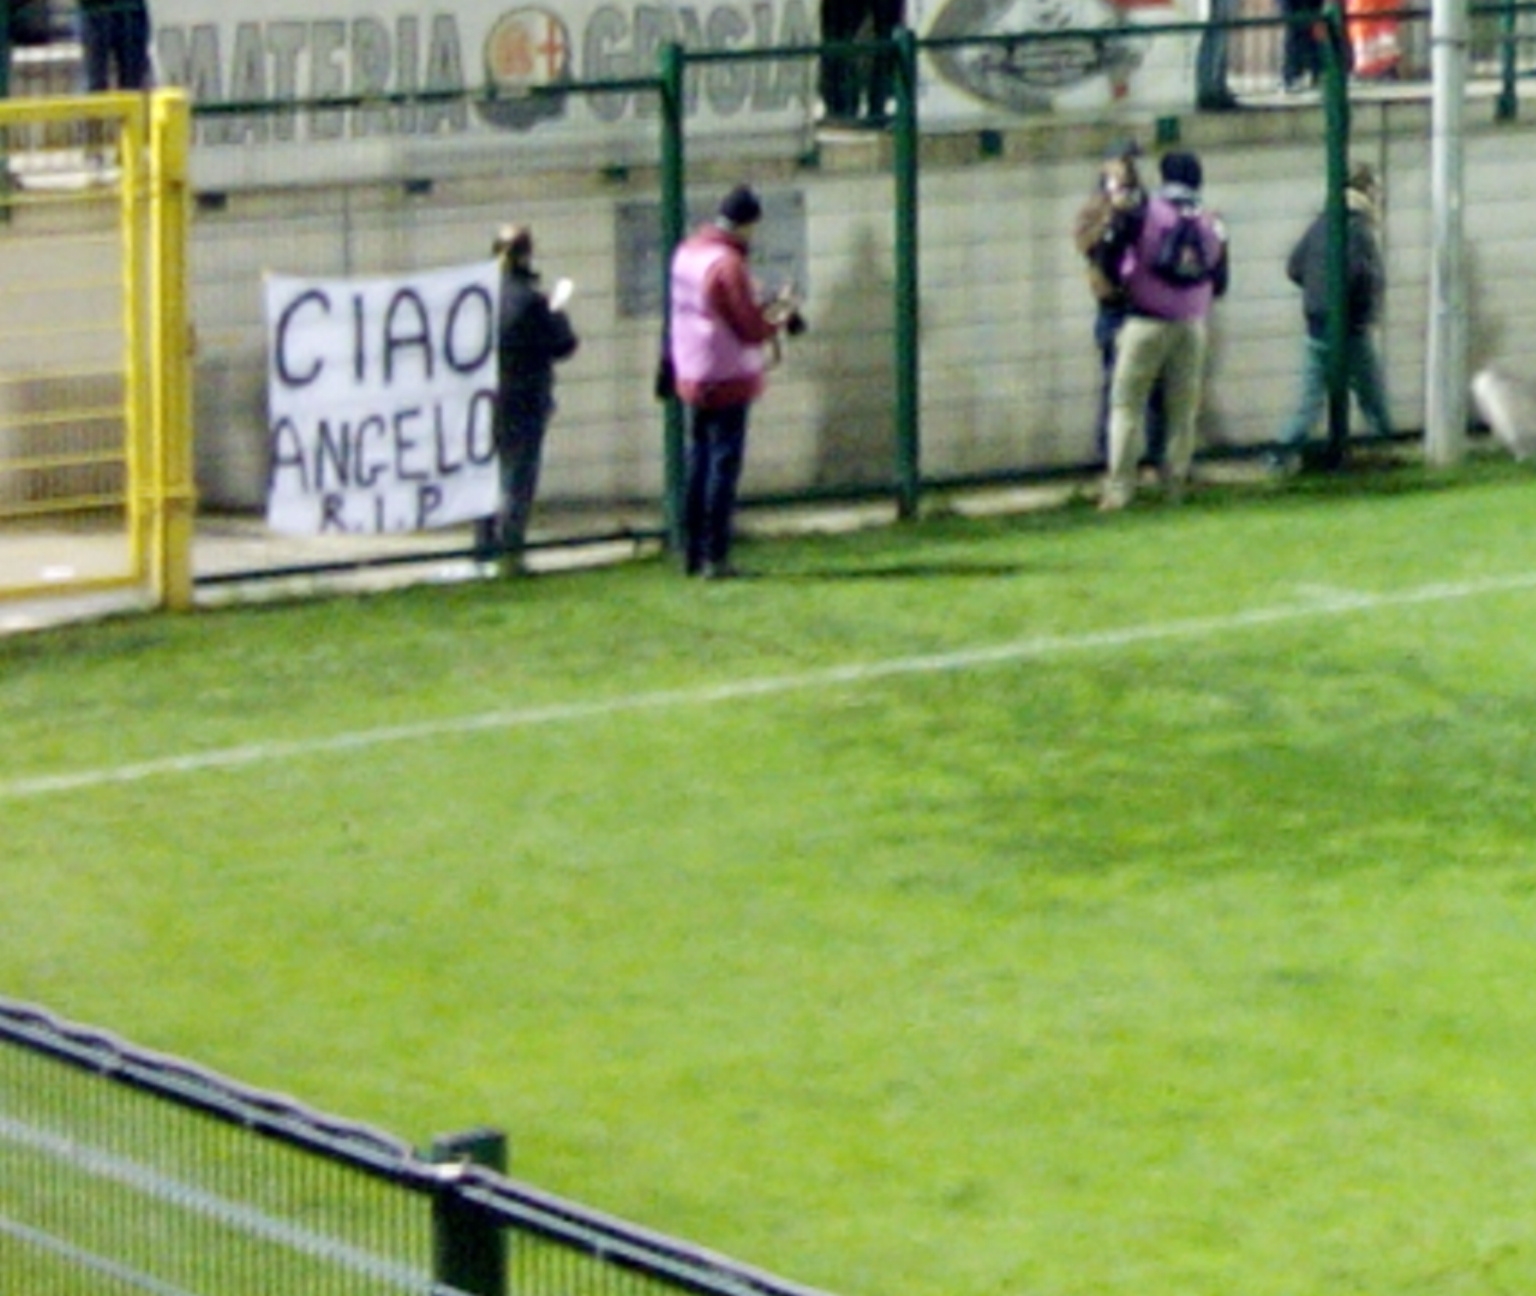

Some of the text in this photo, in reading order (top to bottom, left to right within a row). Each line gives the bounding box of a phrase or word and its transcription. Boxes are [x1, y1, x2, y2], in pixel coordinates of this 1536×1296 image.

[156, 13, 468, 145] MATERIA
[274, 284, 495, 389] CIAO
[268, 387, 499, 494] ANGELO
